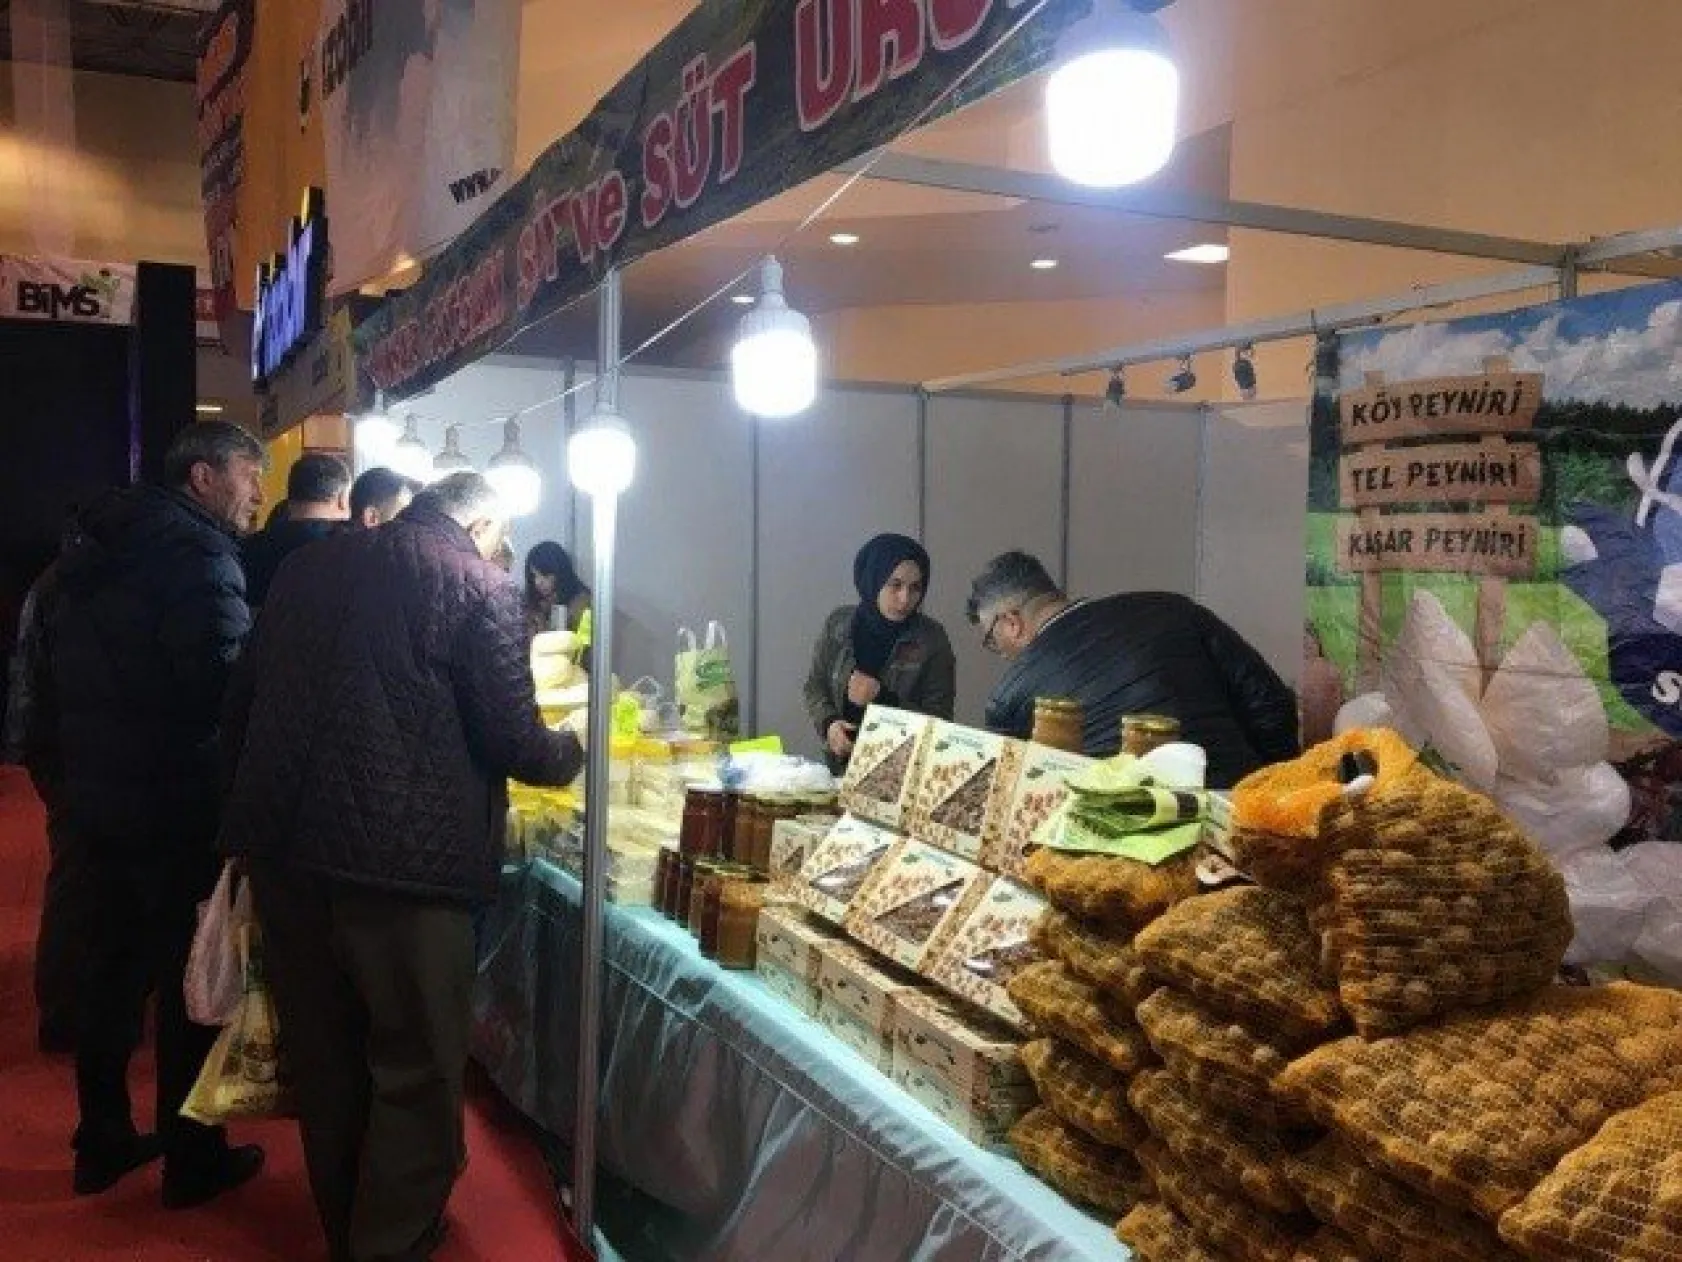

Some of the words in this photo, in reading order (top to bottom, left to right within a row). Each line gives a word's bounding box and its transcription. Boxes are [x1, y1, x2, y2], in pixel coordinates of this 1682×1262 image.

[641, 40, 757, 228] SÜT
[1408, 380, 1523, 417] PEYNİRİ
[1352, 465, 1394, 493] TEL
[1407, 451, 1518, 488] PEYNİRİ
[1424, 522, 1526, 559] PEYNİRİ
